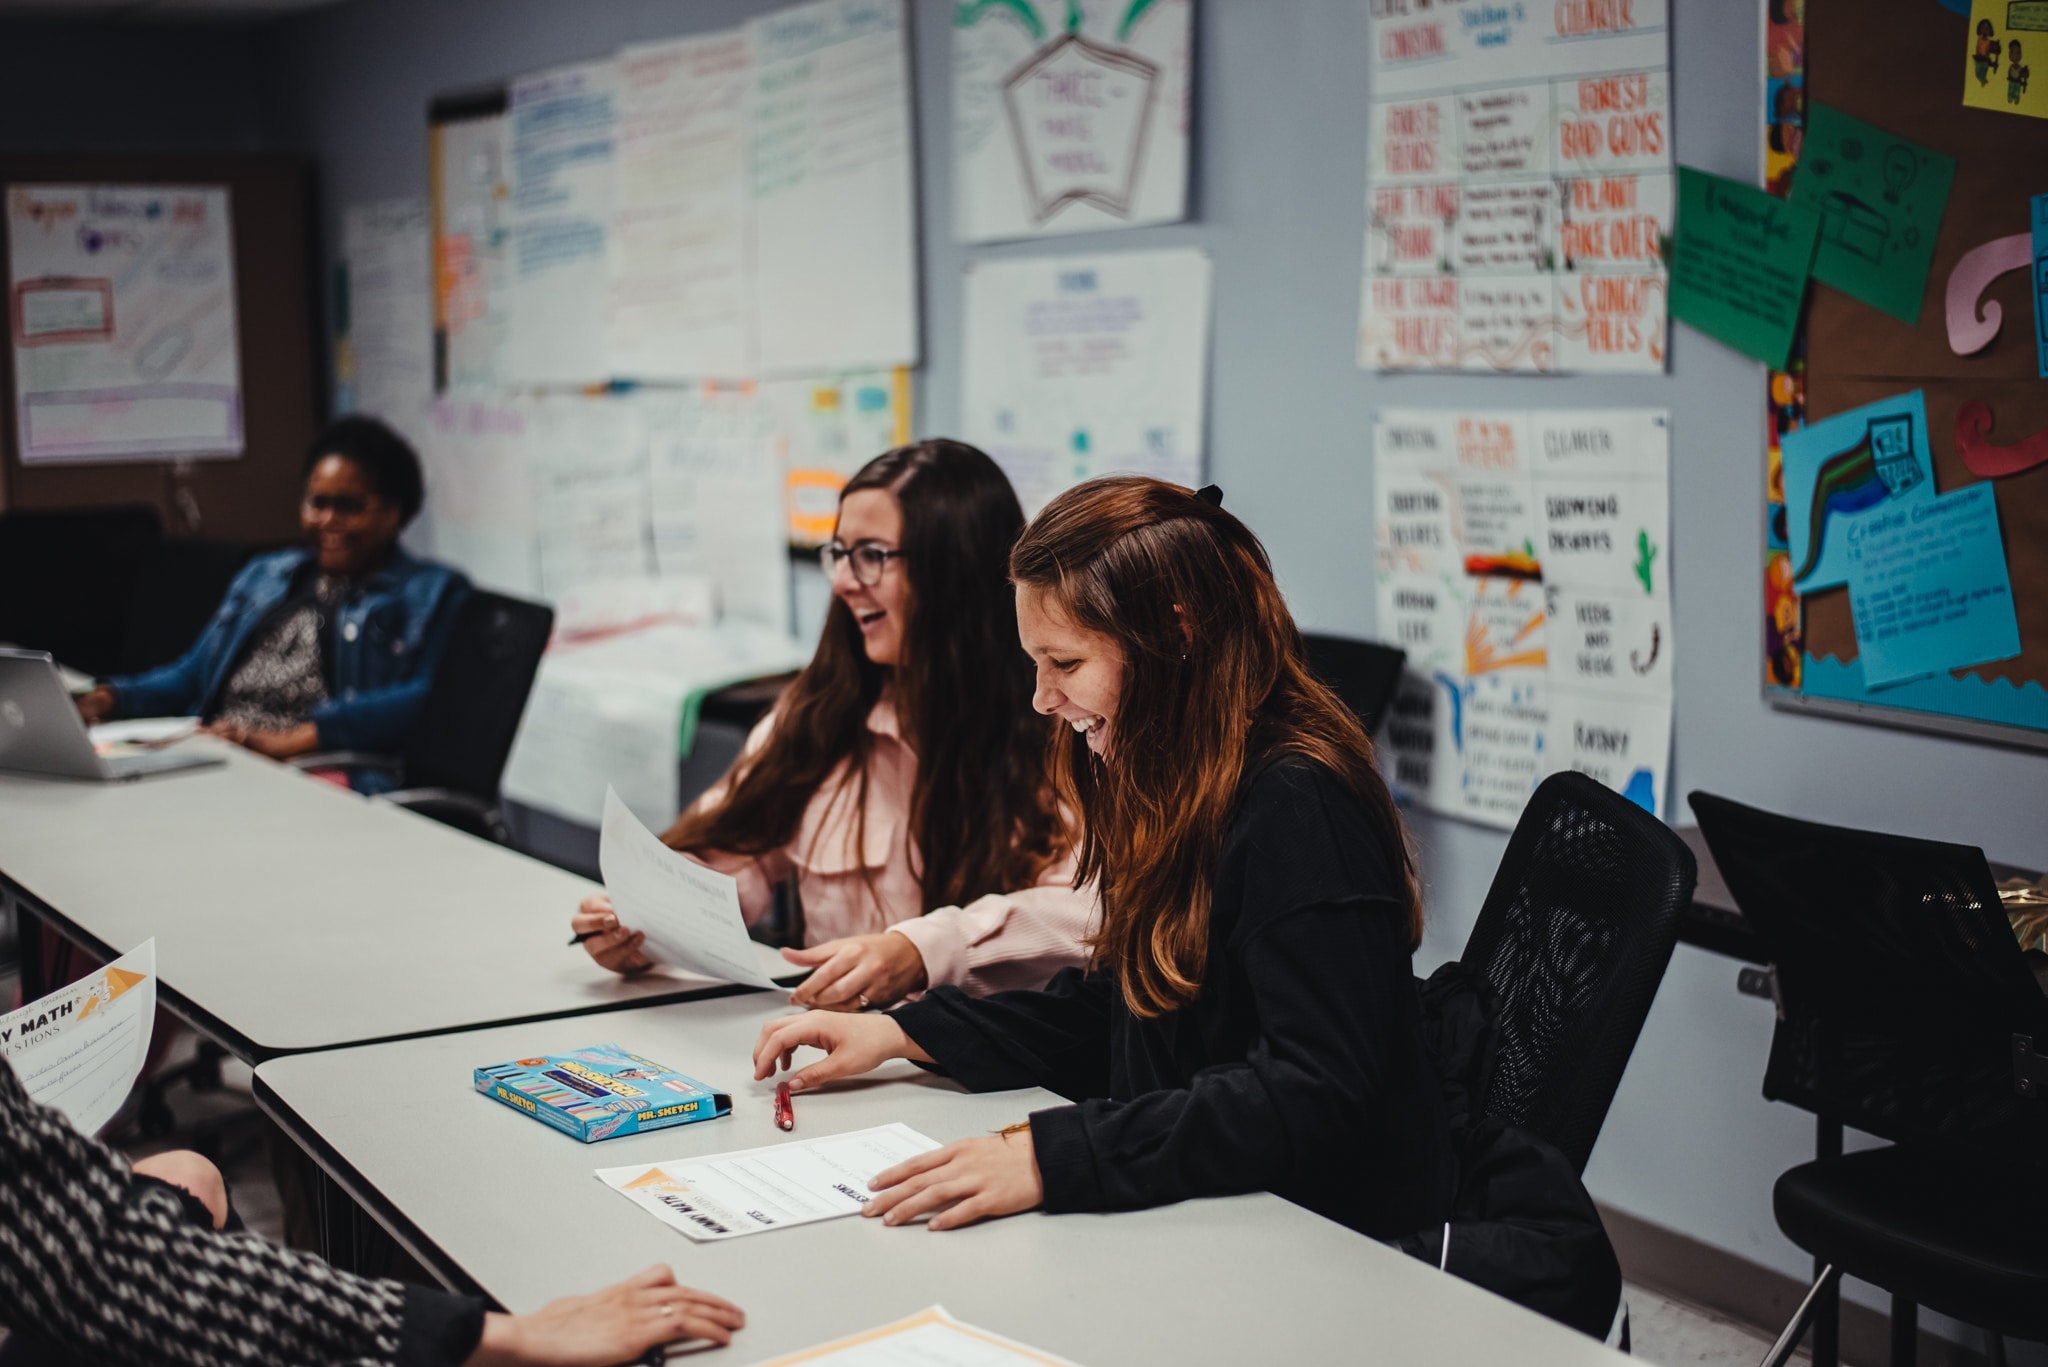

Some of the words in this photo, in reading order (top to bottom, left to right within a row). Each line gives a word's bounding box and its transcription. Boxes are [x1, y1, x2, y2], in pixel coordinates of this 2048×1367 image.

[1578, 73, 1647, 113] FOREST
[1561, 121, 1603, 160] BAD
[1607, 112, 1664, 156] GUYS
[1573, 174, 1638, 212] PLANT
[1609, 215, 1661, 260] OVER
[20, 1000, 73, 1036] MATH
[496, 1086, 509, 1100] MR.
[509, 1092, 537, 1114] SKETCH
[638, 1110, 657, 1122] MR.
[658, 1102, 699, 1118] SKETCH
[658, 1195, 694, 1213] MATH
